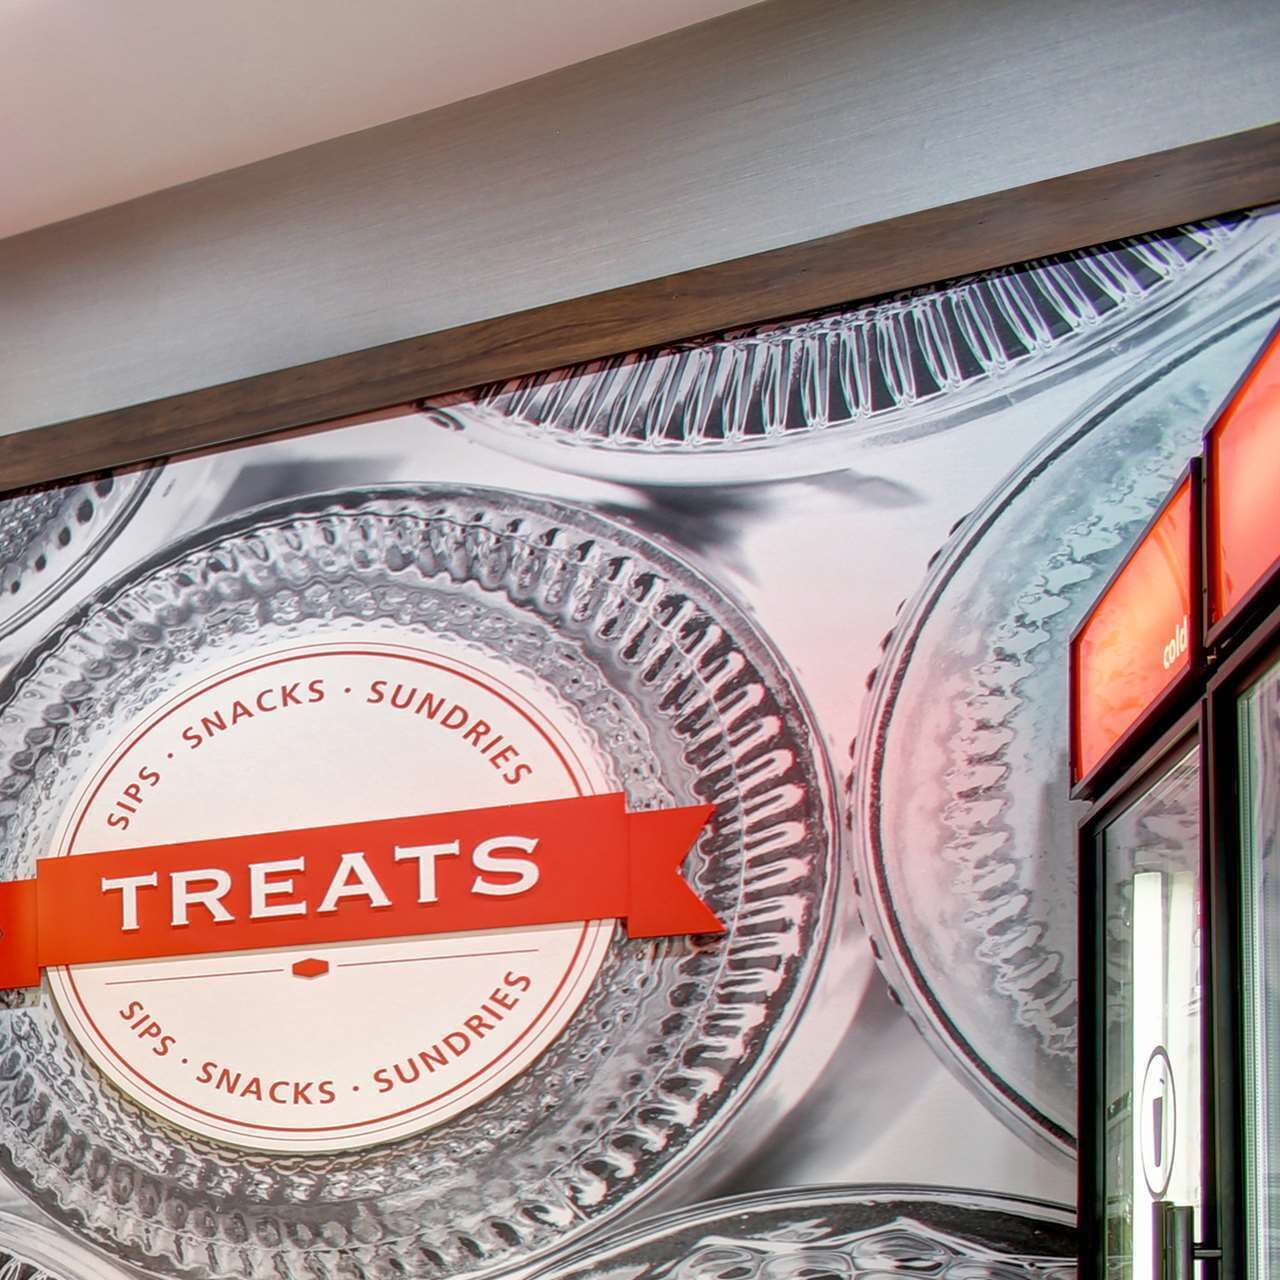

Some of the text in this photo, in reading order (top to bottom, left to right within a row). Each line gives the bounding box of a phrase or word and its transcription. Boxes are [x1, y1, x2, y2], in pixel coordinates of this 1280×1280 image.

[1162, 614, 1188, 672] cold
[107, 678, 534, 833] SIPS SNACKS SUNDRIES
[100, 835, 542, 932] TREATS
[118, 968, 532, 1107] SIPS SNACKS SUNDRIES
